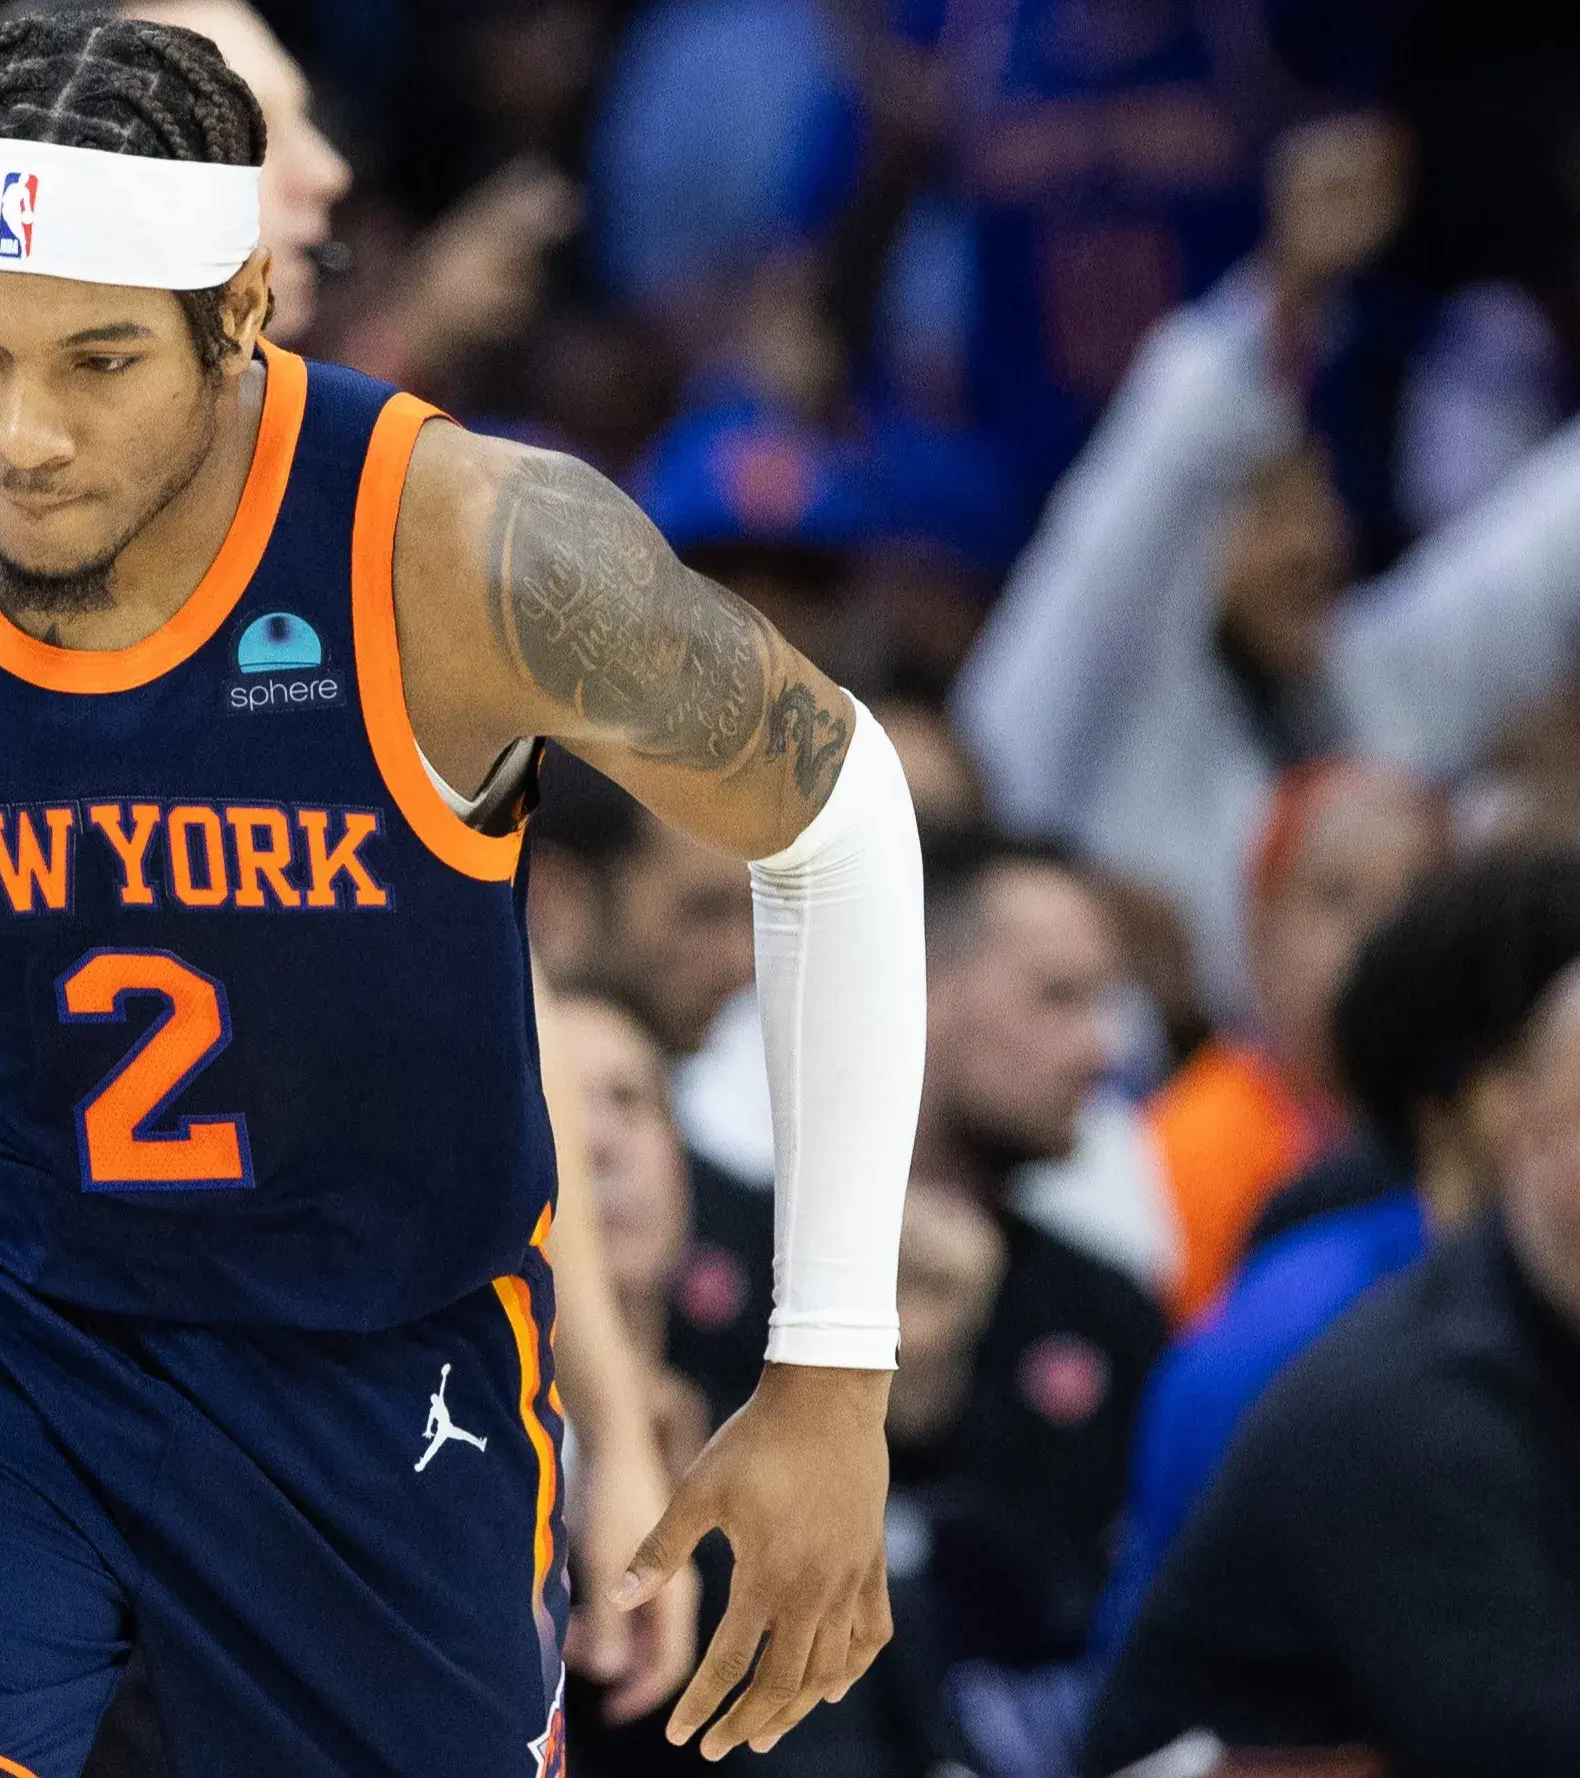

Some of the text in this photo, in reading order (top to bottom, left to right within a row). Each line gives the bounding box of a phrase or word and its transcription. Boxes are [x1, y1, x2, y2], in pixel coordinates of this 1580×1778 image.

[230, 676, 338, 712] sphere
[87, 800, 393, 912] YORK
[53, 946, 256, 1193] 2
